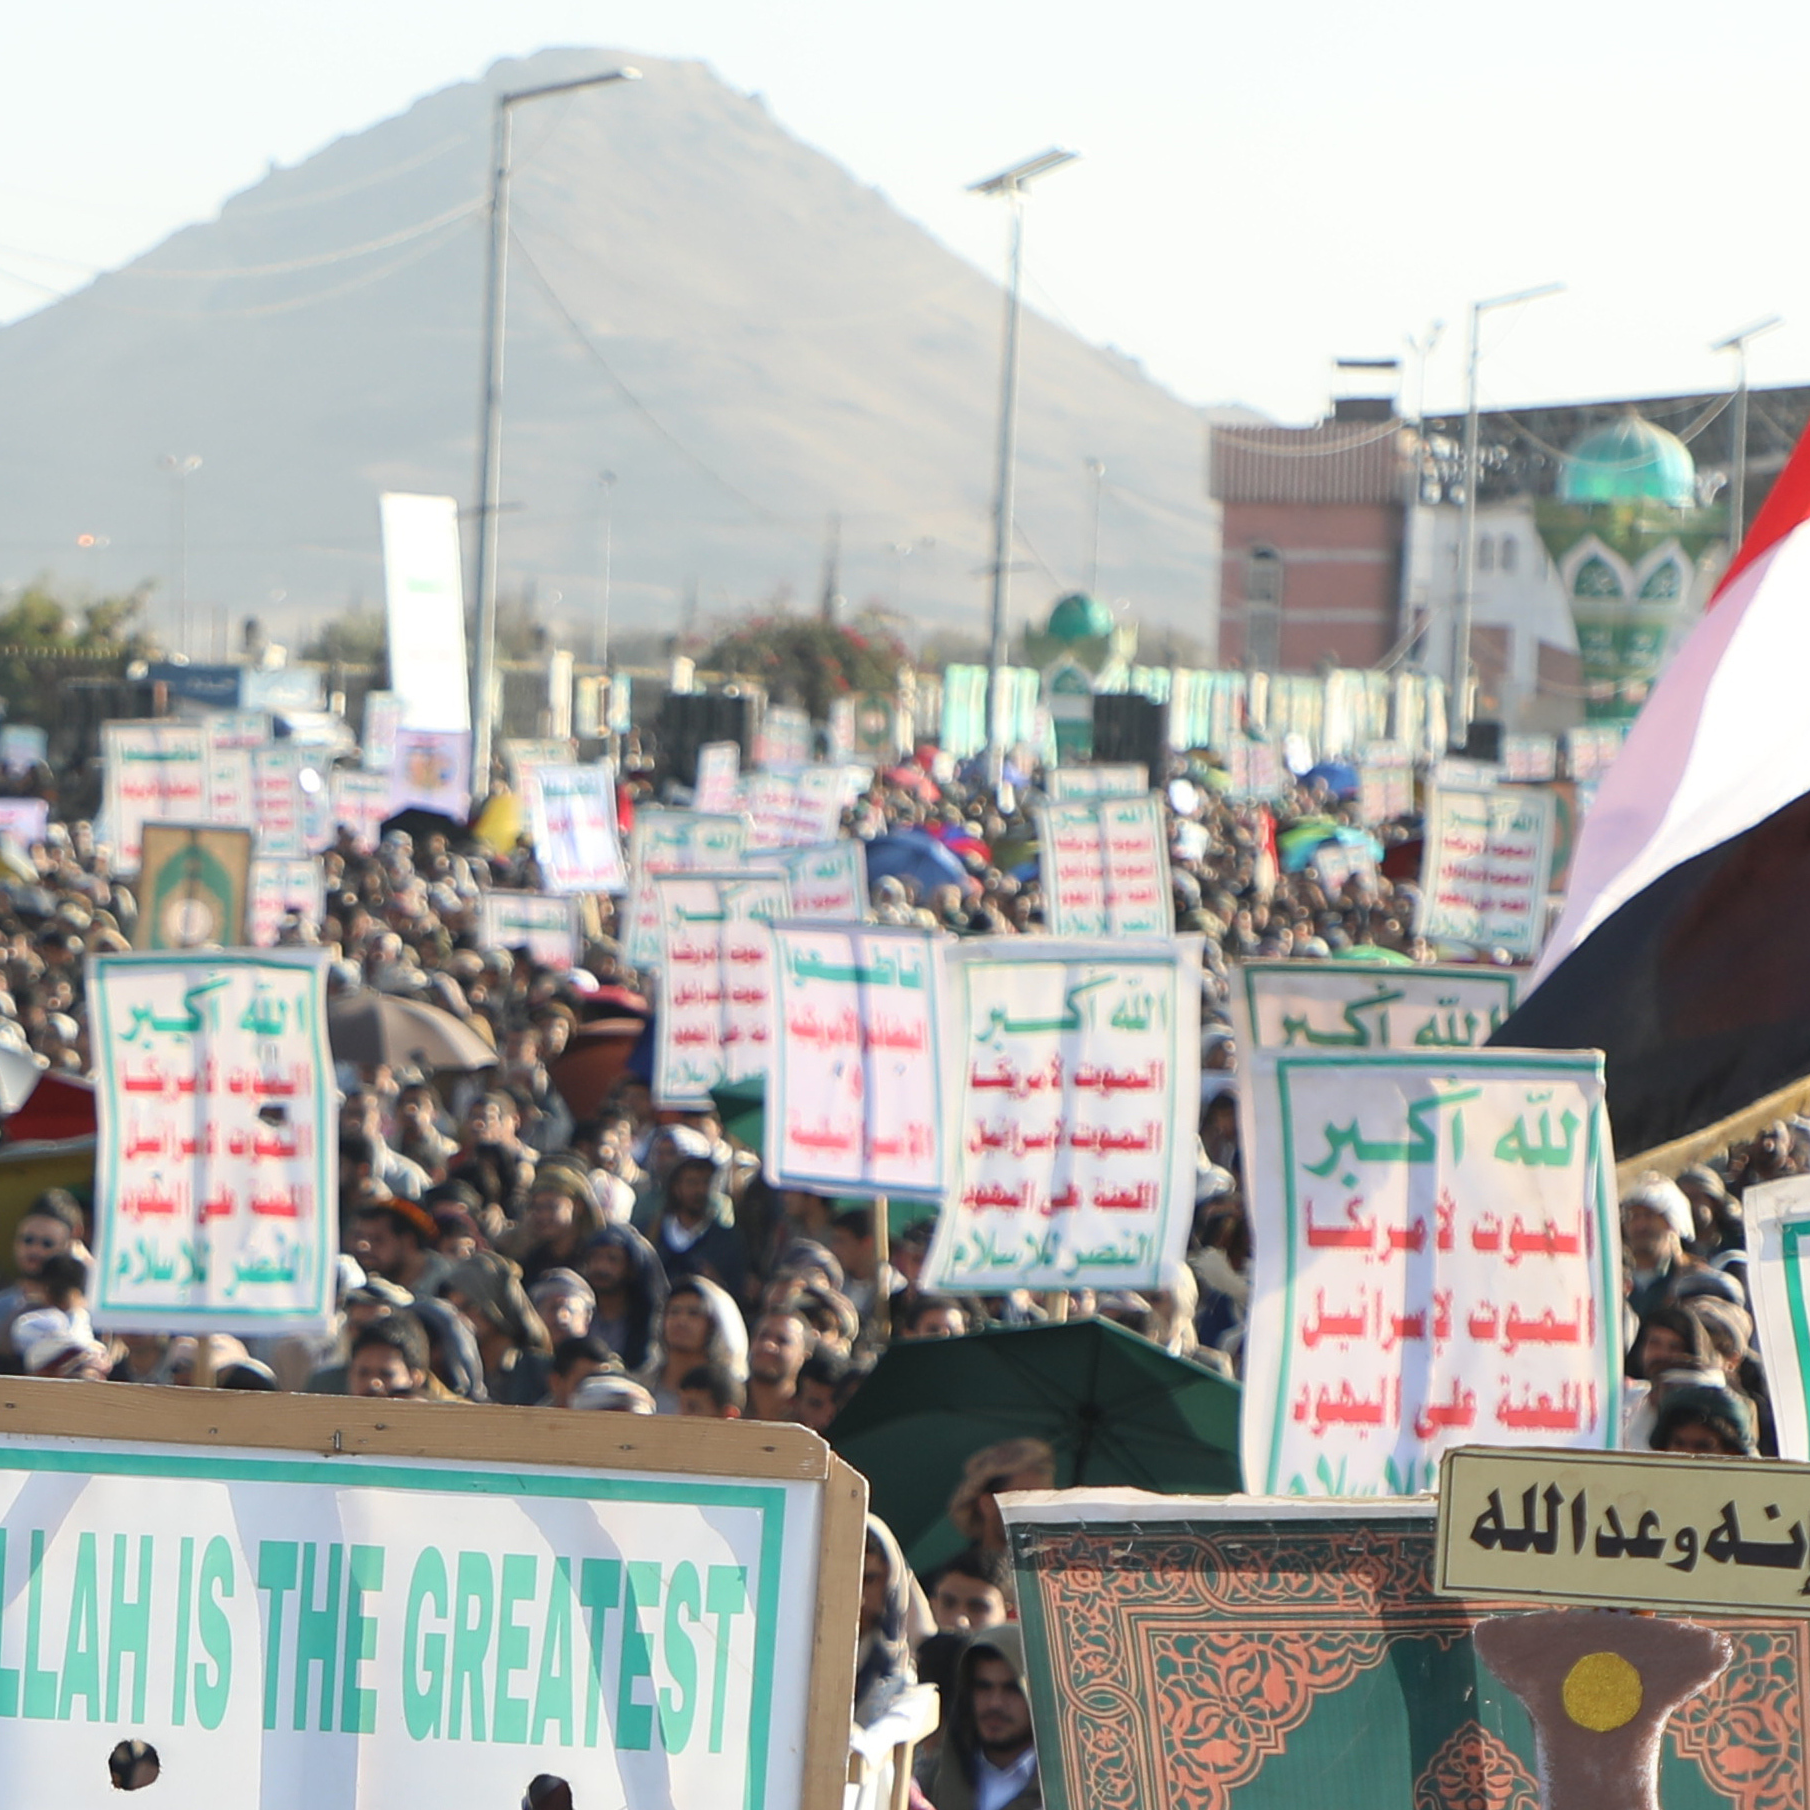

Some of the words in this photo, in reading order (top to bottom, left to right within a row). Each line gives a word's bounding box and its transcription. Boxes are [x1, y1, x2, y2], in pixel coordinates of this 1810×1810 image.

[1302, 1074, 1483, 1189] أكبر
[1303, 1186, 1456, 1265] لأمريكا
[1470, 1206, 1594, 1267] الموت
[1302, 1279, 1454, 1355] لإسرائيل
[1468, 1292, 1596, 1355] الموت
[1293, 1370, 1402, 1440] اليهود
[1414, 1374, 1478, 1440] على
[1495, 1372, 1597, 1437] اللعنة
[1468, 1481, 1589, 1558] الله
[171, 1533, 234, 1733] IS
[258, 1538, 384, 1735] THE
[400, 1544, 749, 1757] GREATEST
